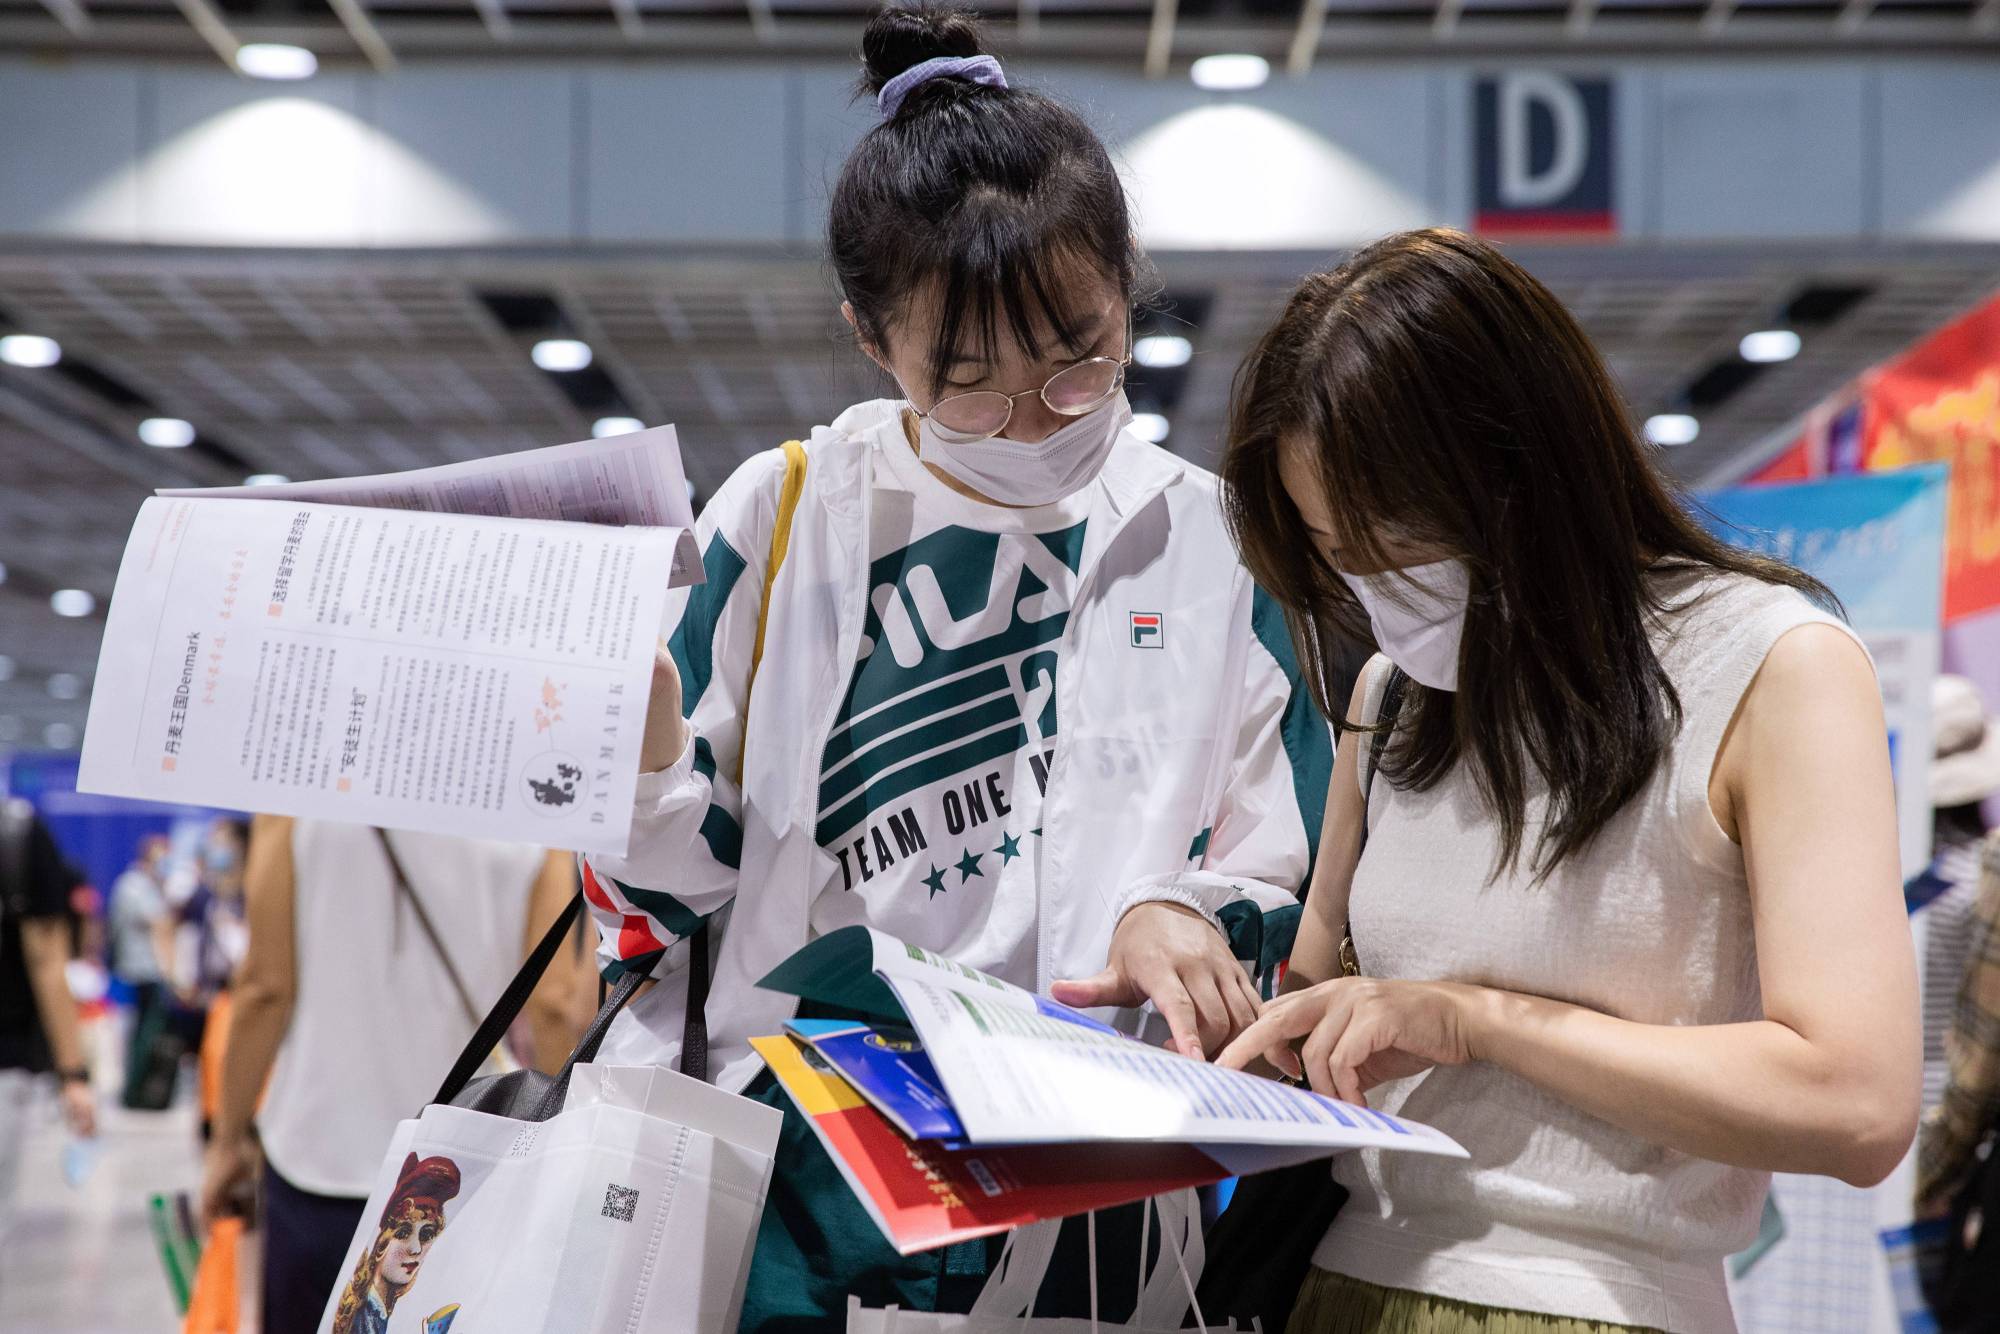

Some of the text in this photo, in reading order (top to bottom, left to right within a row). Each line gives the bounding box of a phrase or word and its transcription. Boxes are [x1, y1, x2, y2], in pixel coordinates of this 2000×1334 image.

[1497, 70, 1591, 206] D
[857, 534, 1077, 668] ILA
[590, 683, 624, 823] DANMARK
[835, 807, 928, 892] TEAM
[942, 771, 1011, 836] ONE
